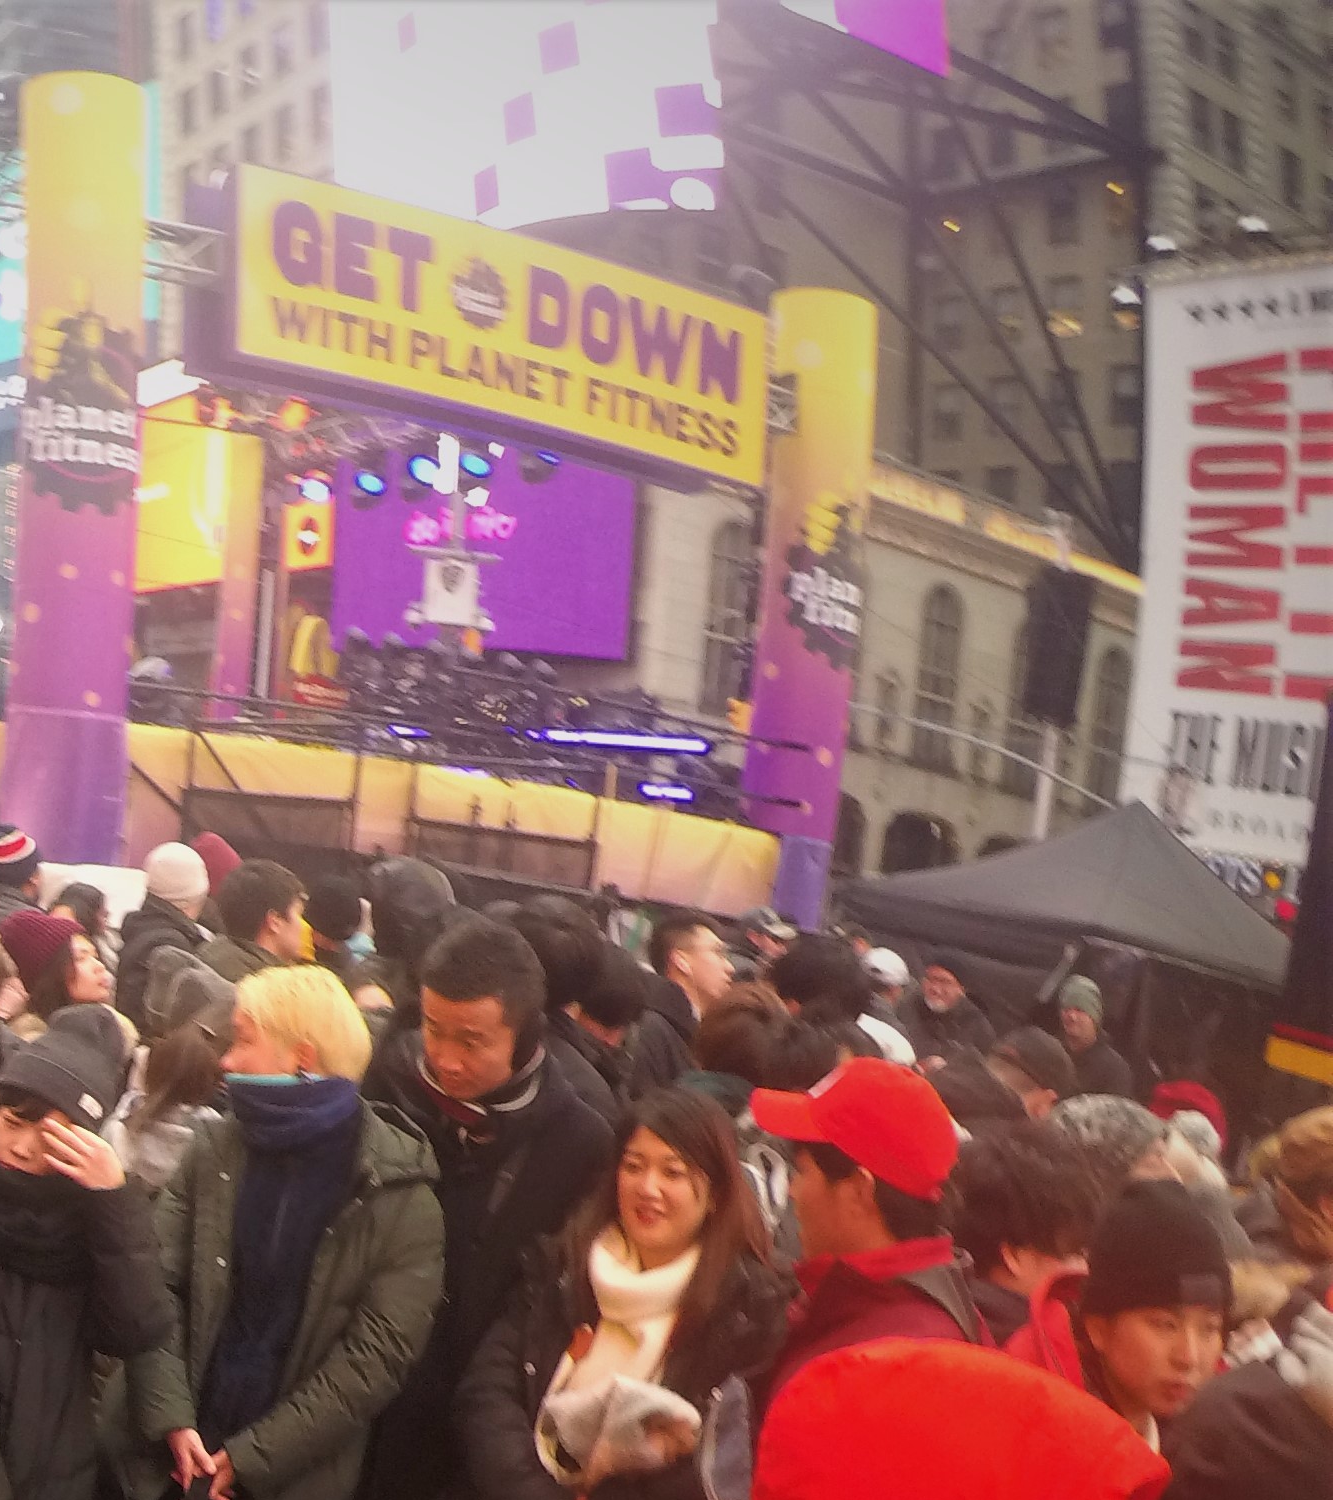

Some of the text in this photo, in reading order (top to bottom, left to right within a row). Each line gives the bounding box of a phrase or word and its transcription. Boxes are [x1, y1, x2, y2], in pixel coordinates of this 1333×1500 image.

[269, 295, 394, 363] WITH
[409, 329, 574, 407] PLANET
[587, 378, 741, 457] FITNESS
[272, 200, 744, 405] GET DOWN
[1175, 352, 1289, 696] WOMAN
[1165, 711, 1222, 785] THE
